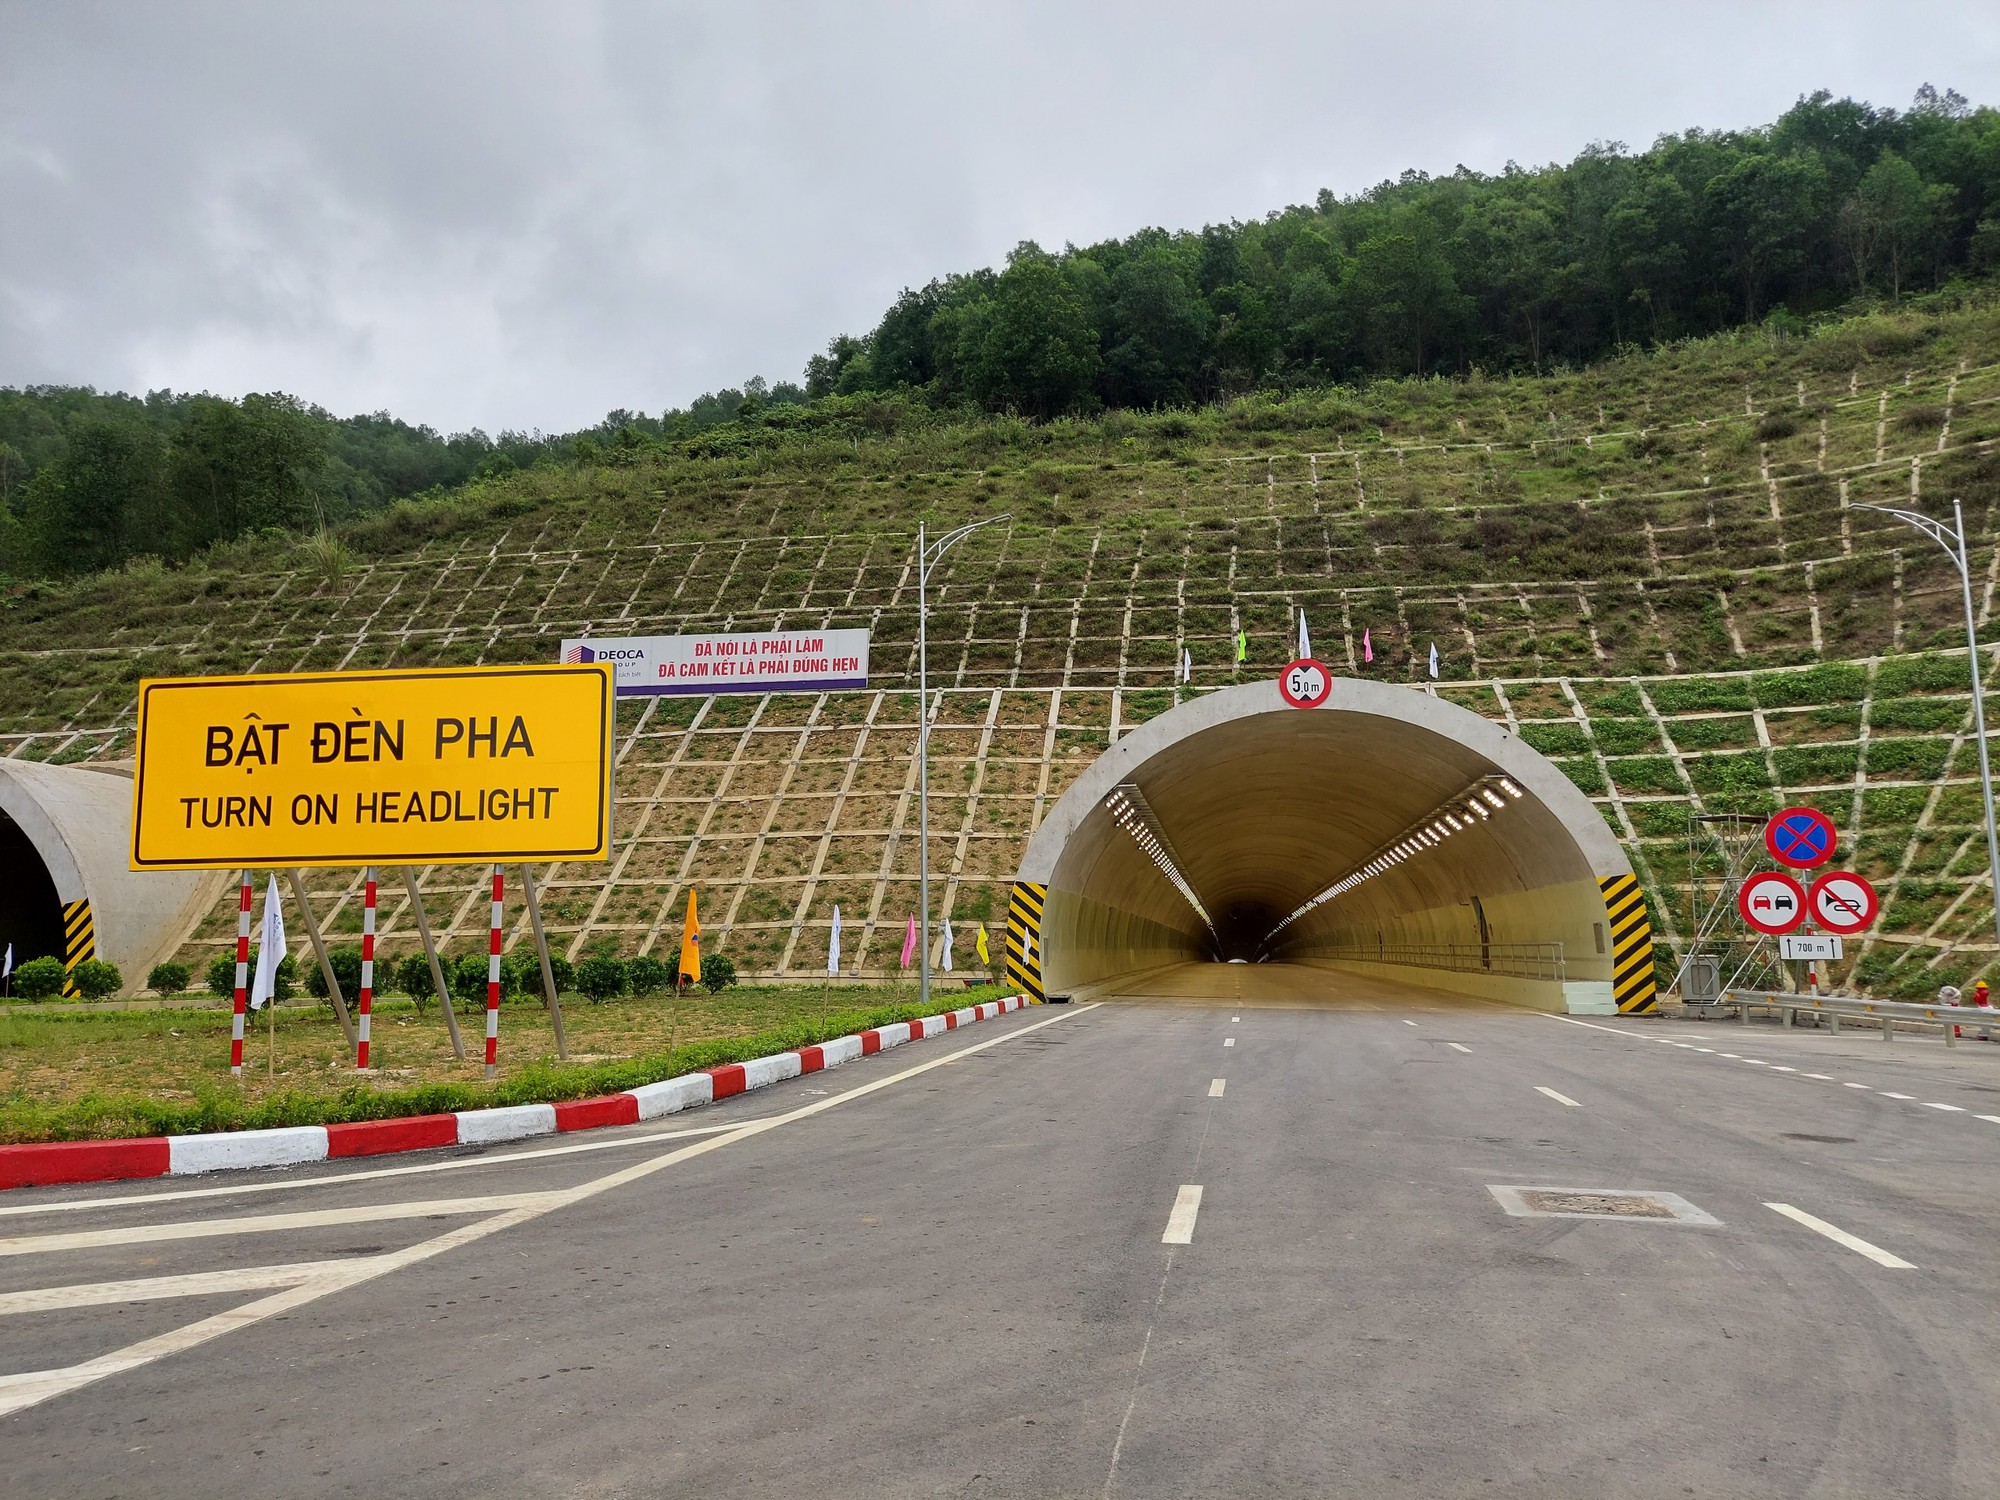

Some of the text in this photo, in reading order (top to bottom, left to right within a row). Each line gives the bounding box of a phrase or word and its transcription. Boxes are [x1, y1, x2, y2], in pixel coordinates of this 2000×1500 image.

[599, 650, 644, 660] DEOCA
[695, 634, 823, 656] ĐÃ NÓI LÀ PHẢI LÀM
[658, 655, 859, 678] ĐÃ CAM KẾT LÀ PHẢI ĐÚNG HẸN
[1311, 684, 1319, 692] m
[205, 707, 535, 774] BẬT ĐÈN PHA
[180, 787, 560, 828] TURN ON HEADLIGHT
[1797, 943, 1812, 952] 700
